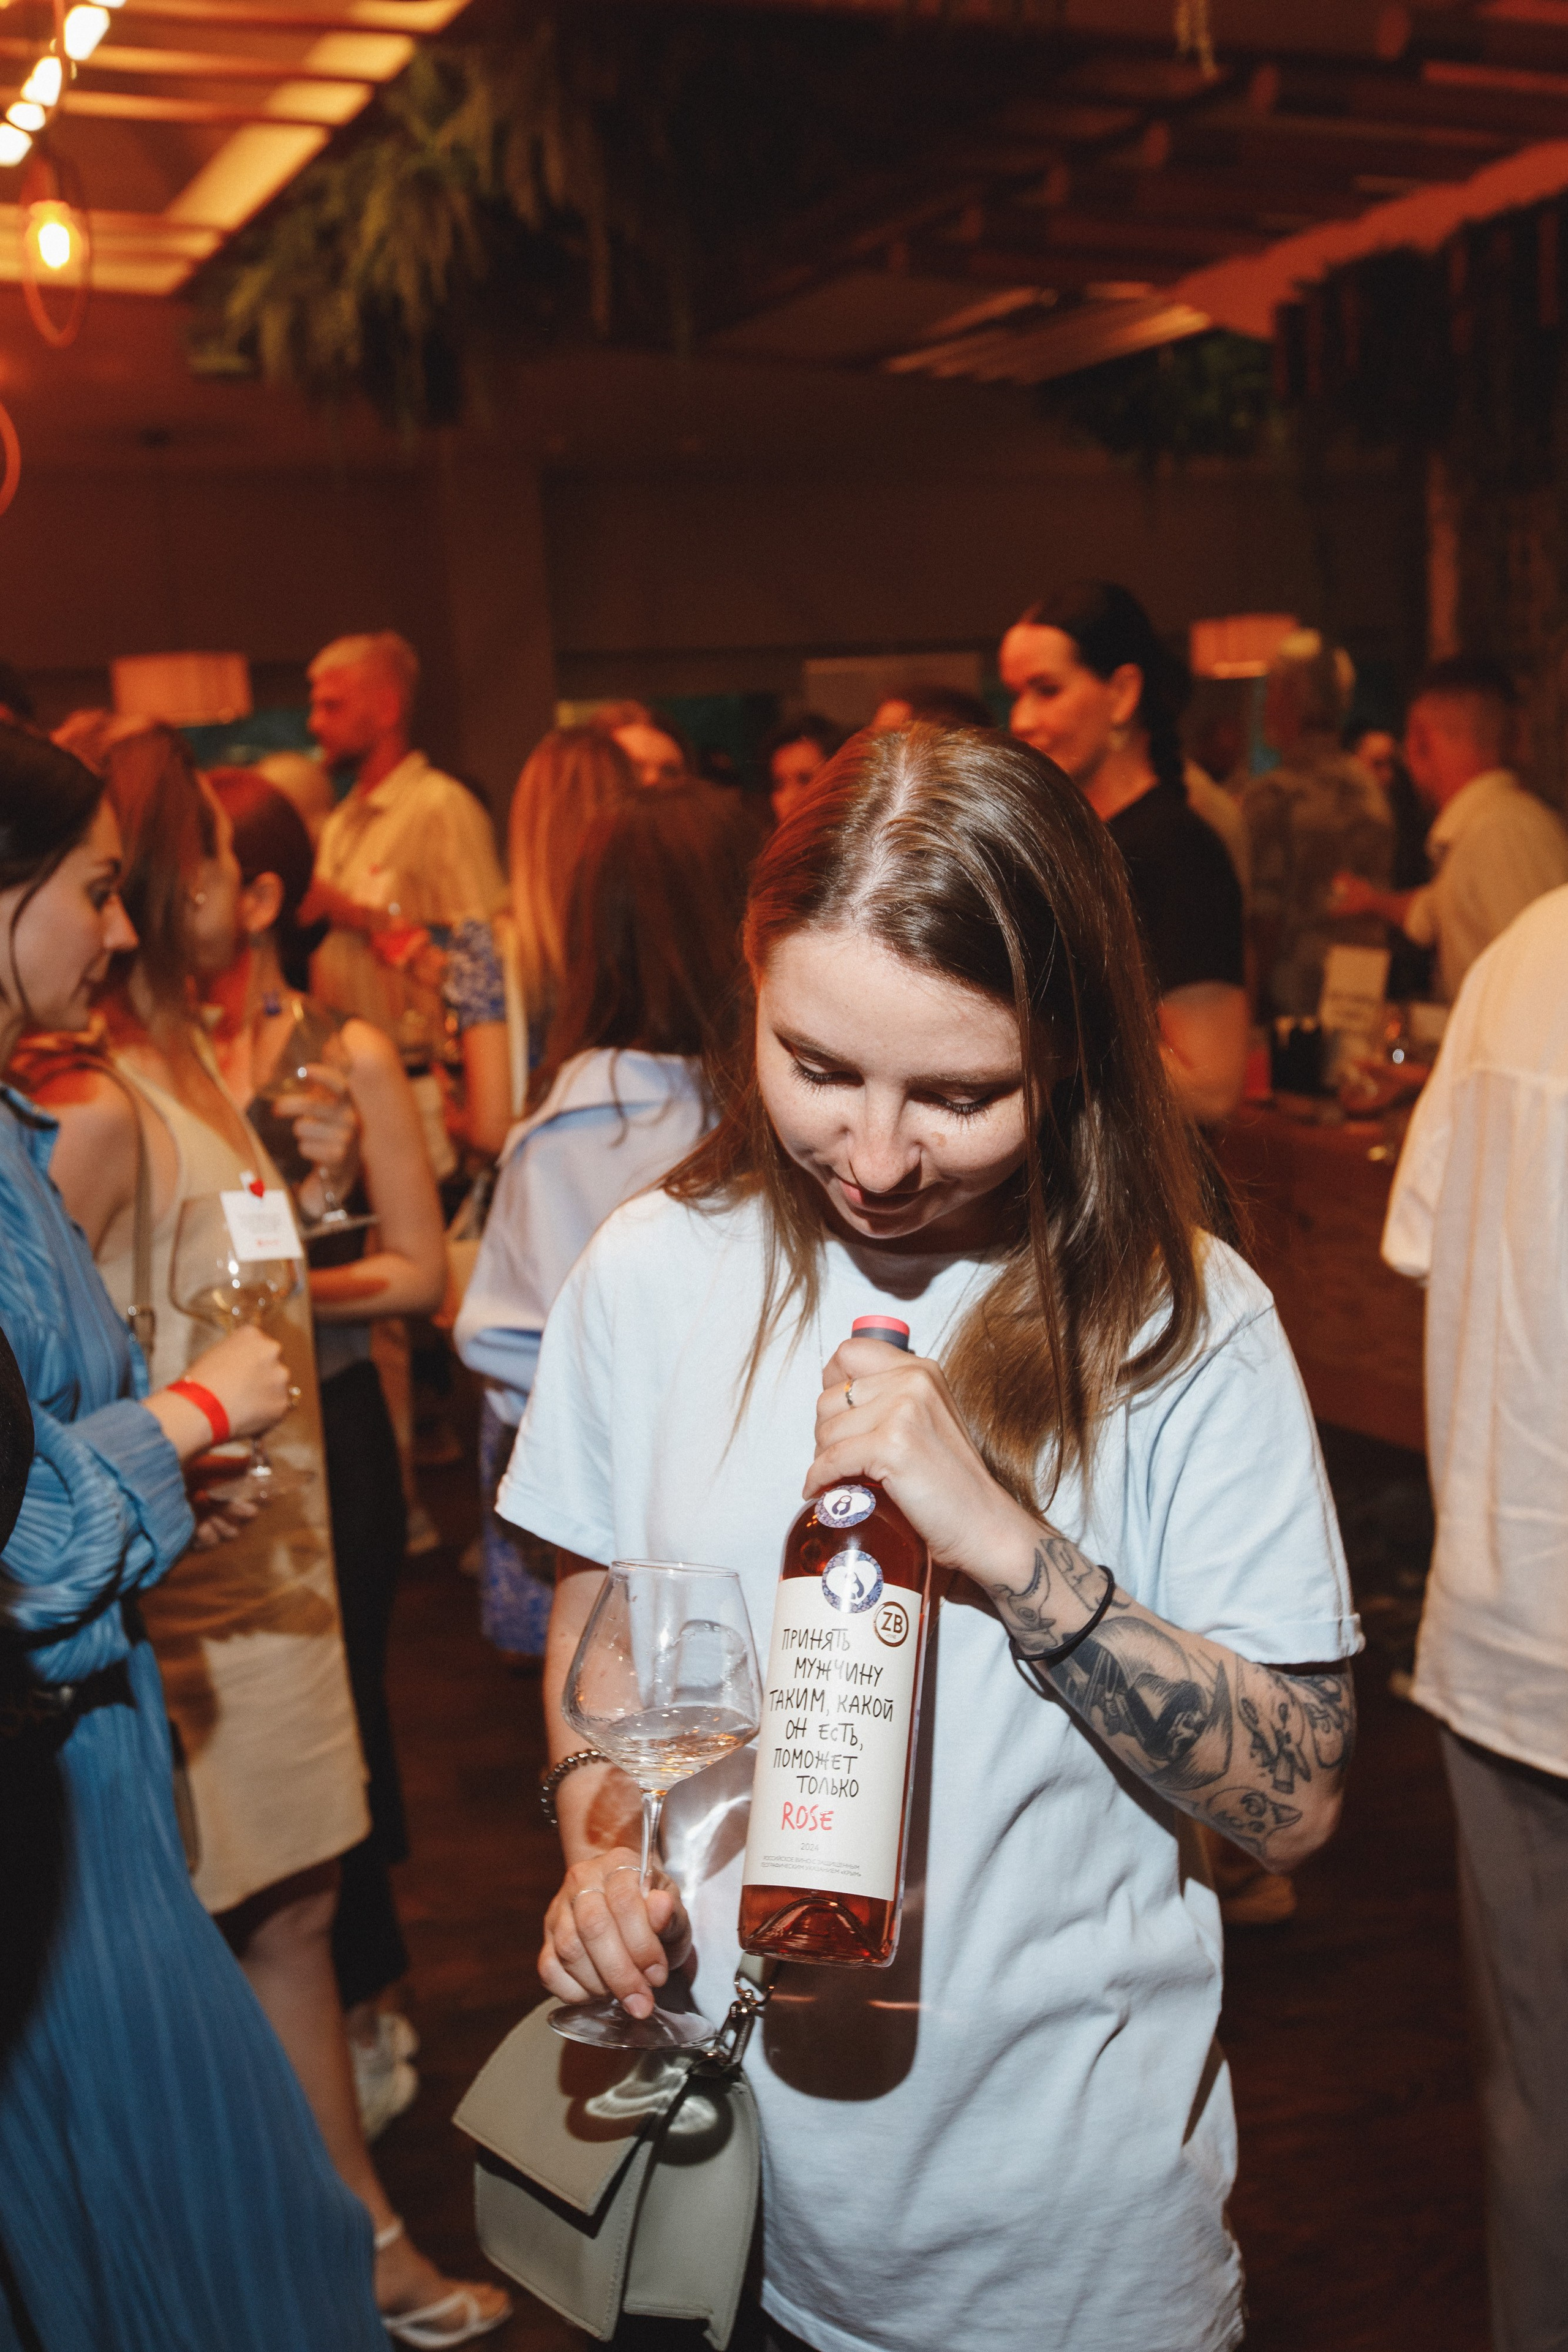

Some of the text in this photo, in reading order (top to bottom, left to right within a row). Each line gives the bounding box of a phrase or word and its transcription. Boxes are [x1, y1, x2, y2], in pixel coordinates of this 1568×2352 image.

[881, 1611, 903, 1634] ZB
[781, 1628, 850, 1651] ПРИНЯТЬ
[794, 1656, 883, 1687] МУЖЧИНУ
[769, 1687, 894, 1722] ТАКИМ, КАКОЙ
[785, 1717, 807, 1740] ОН
[773, 1747, 858, 1774] ПОМОЖЕТ
[796, 1774, 859, 1798] ТОЛЬКО
[781, 1801, 834, 1831] ROSE
[800, 1842, 819, 1851] 2024
